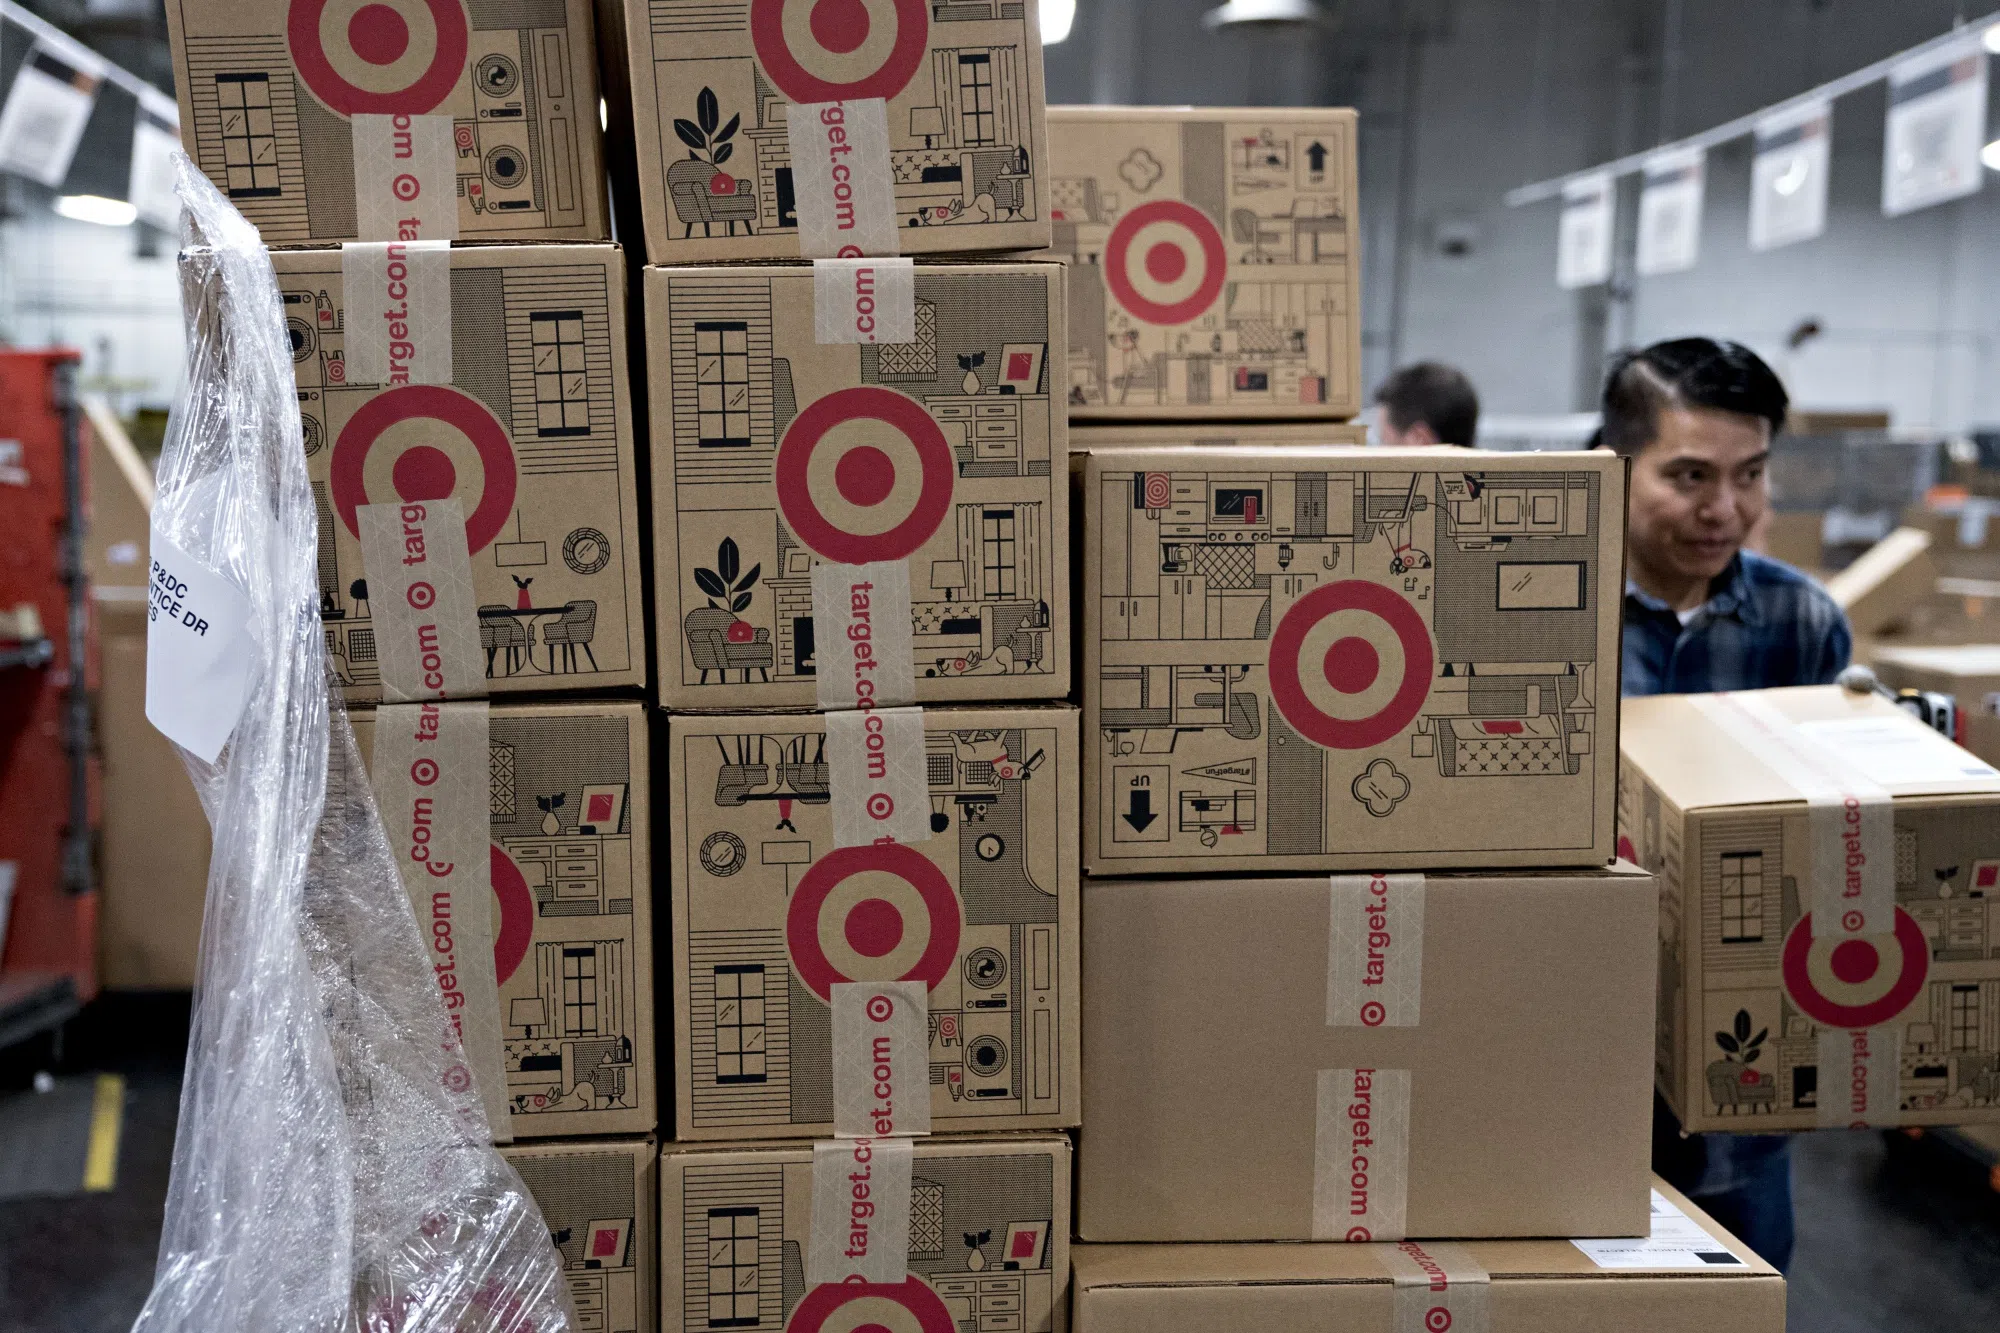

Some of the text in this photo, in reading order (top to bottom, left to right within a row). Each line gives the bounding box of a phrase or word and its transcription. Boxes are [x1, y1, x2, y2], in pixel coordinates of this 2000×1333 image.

[153, 561, 188, 599] P&DC
[182, 611, 209, 637] DR
[1130, 775, 1150, 787] UP
[1205, 767, 1250, 776] #TargetFun
